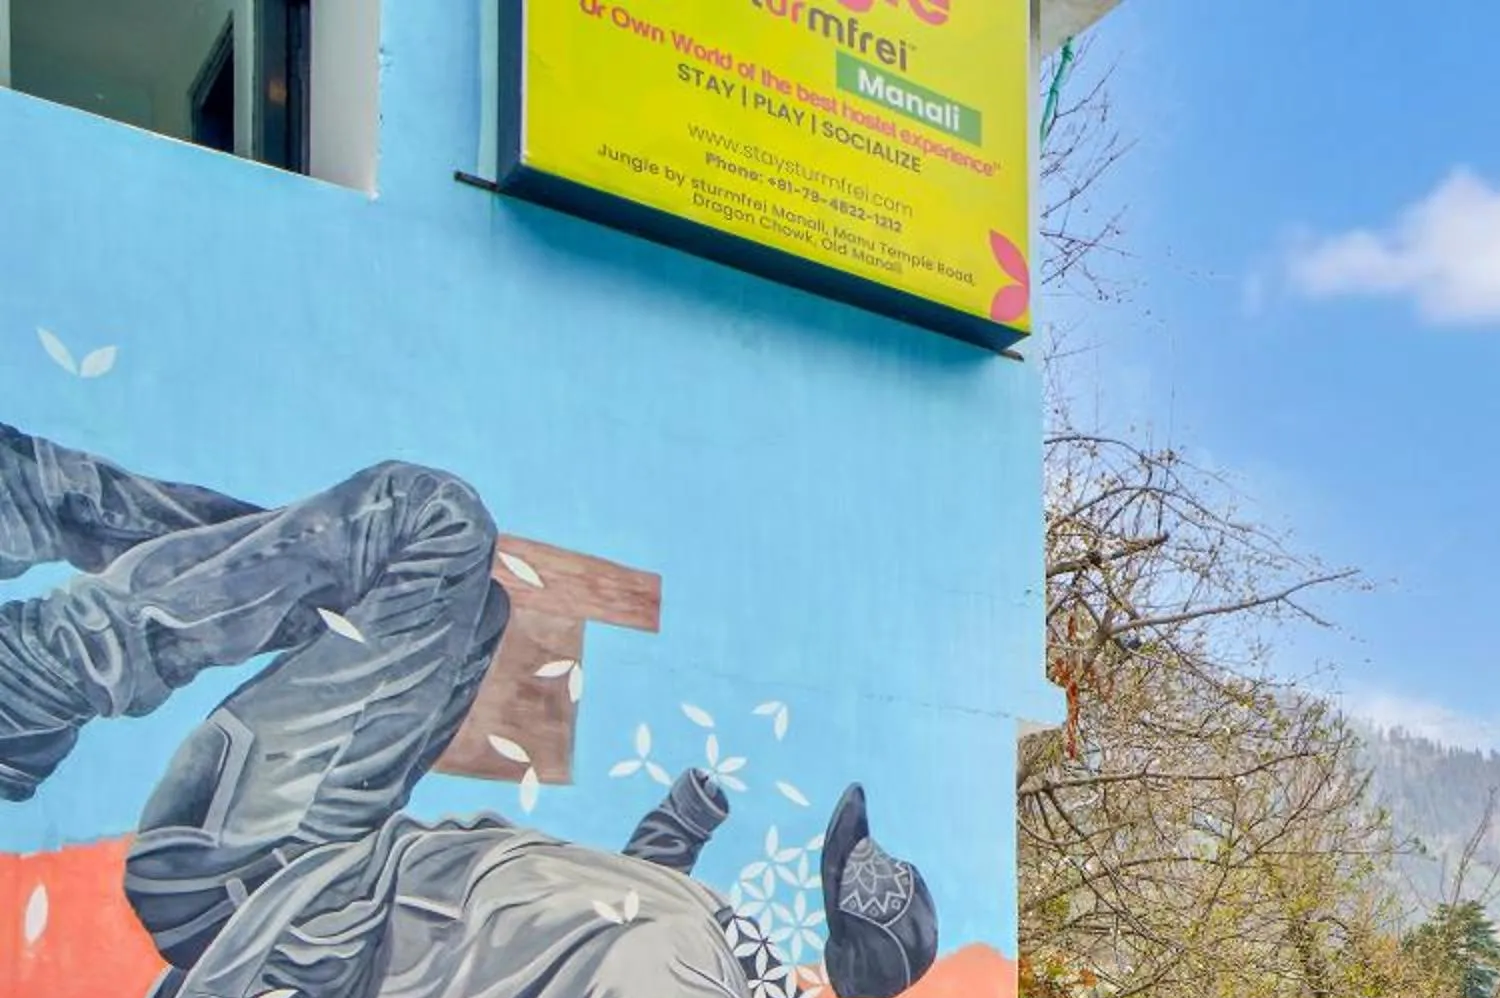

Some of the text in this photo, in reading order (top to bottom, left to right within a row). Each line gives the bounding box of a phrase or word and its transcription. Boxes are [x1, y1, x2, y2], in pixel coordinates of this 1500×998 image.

[611, 6, 665, 44] Own
[671, 30, 733, 71] World
[737, 61, 756, 80] of
[761, 67, 792, 95] the
[796, 83, 837, 115] best
[842, 101, 896, 138] hostel
[677, 63, 735, 99] STAY
[754, 92, 805, 127] PLAY
[822, 120, 922, 173] SOCIALIZE
[857, 66, 960, 132] Manali
[598, 143, 660, 174] Jungle
[664, 166, 685, 187] by
[691, 177, 767, 212] sturmfrei
[833, 225, 875, 250] Manu
[879, 241, 934, 272] Temple
[687, 122, 914, 219] www.staysturmfrei.com
[705, 152, 763, 183] Phone:
[692, 192, 756, 224] Dragon
[821, 237, 848, 256] Old
